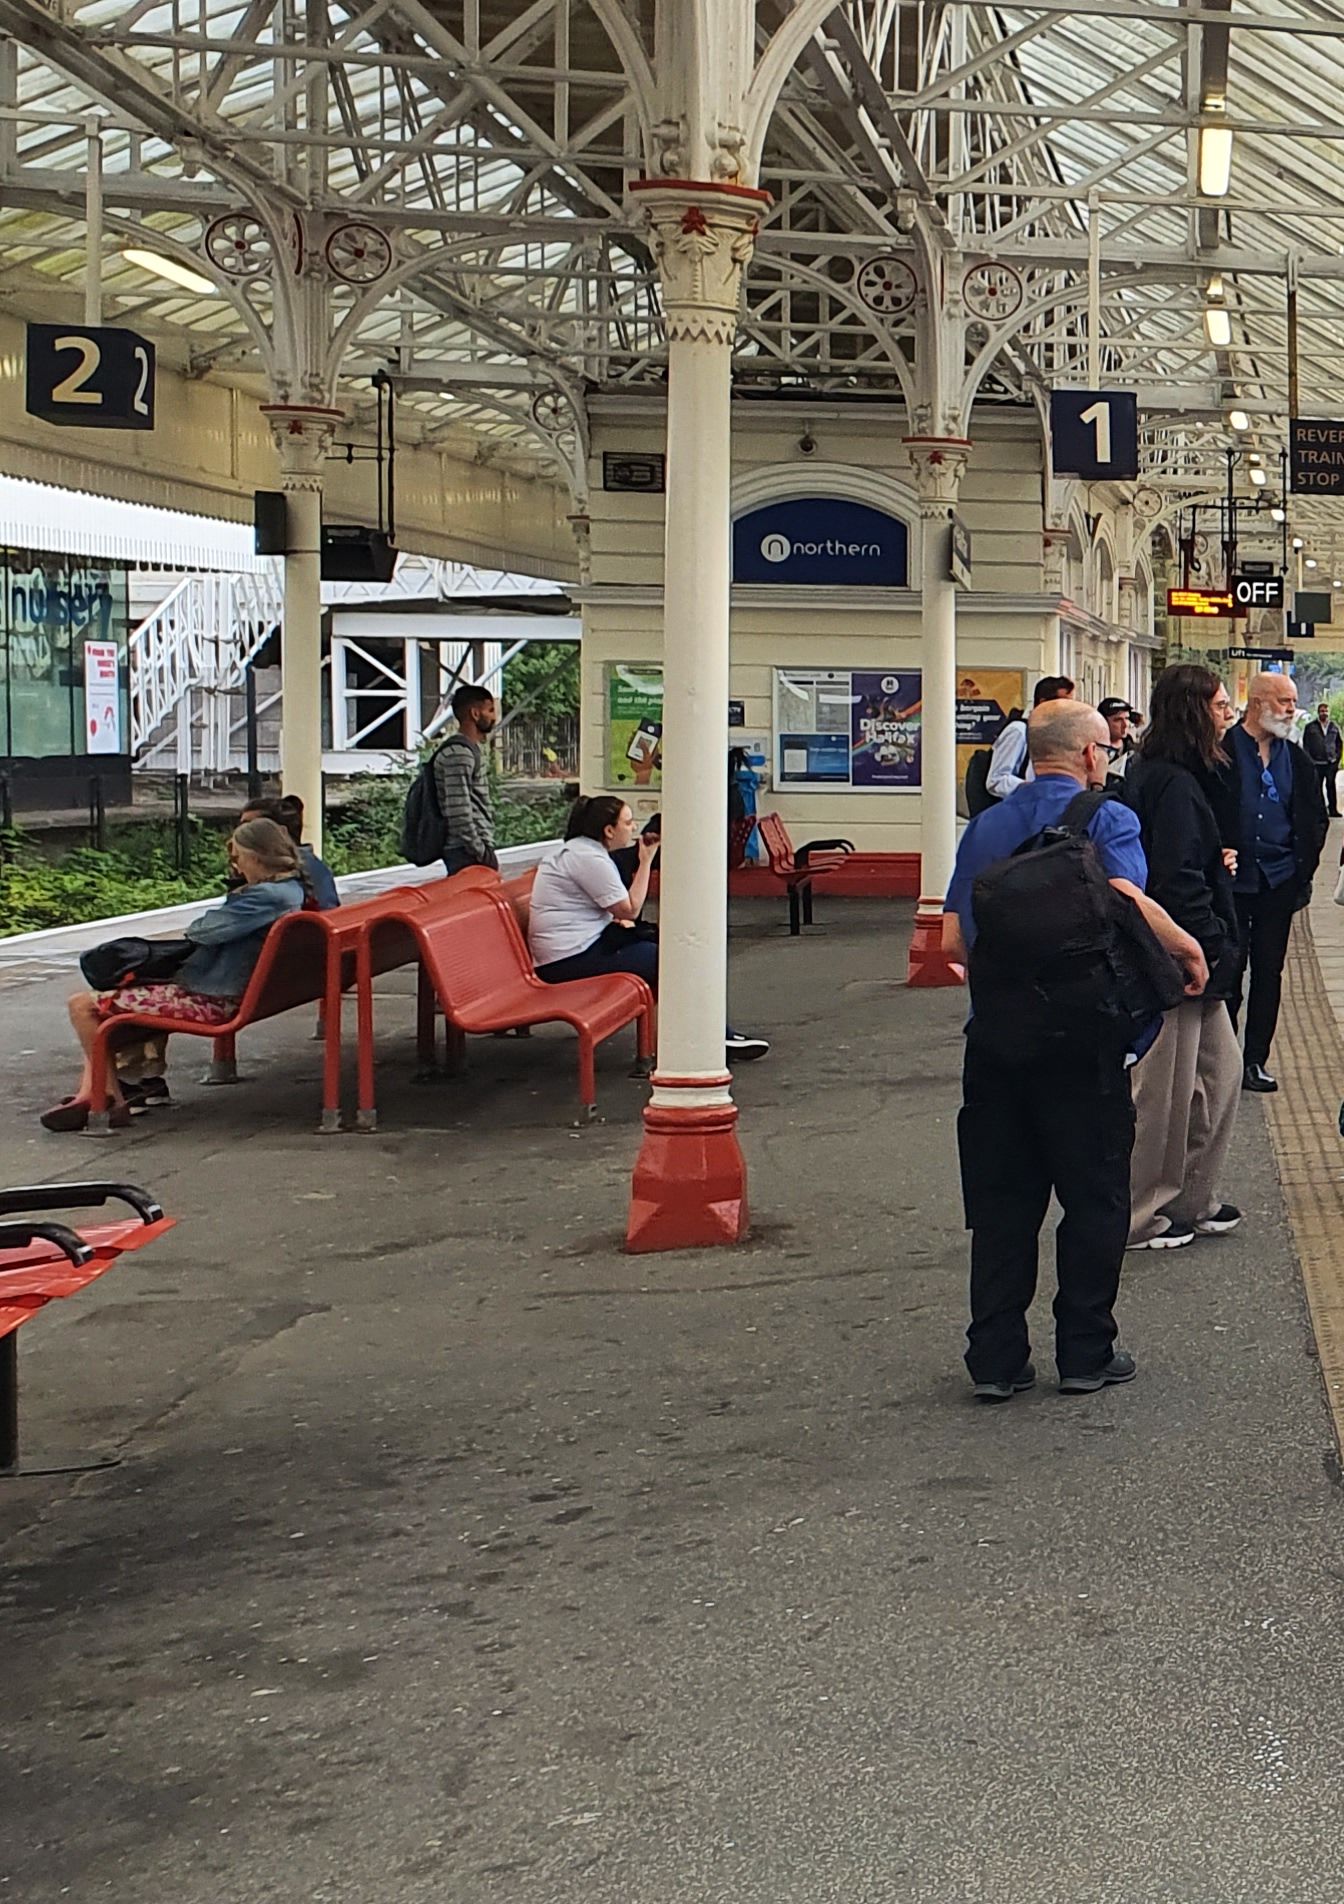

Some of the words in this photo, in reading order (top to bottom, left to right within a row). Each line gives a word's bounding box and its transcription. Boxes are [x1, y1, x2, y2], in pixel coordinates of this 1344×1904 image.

[52, 336, 102, 404] 2
[134, 346, 149, 416] 2
[1079, 402, 1111, 463] 1
[1297, 471, 1340, 486] STOP
[793, 539, 881, 556] northern
[1236, 581, 1279, 603] OFF
[859, 718, 921, 732] Discover
[865, 731, 916, 744] Halifax
